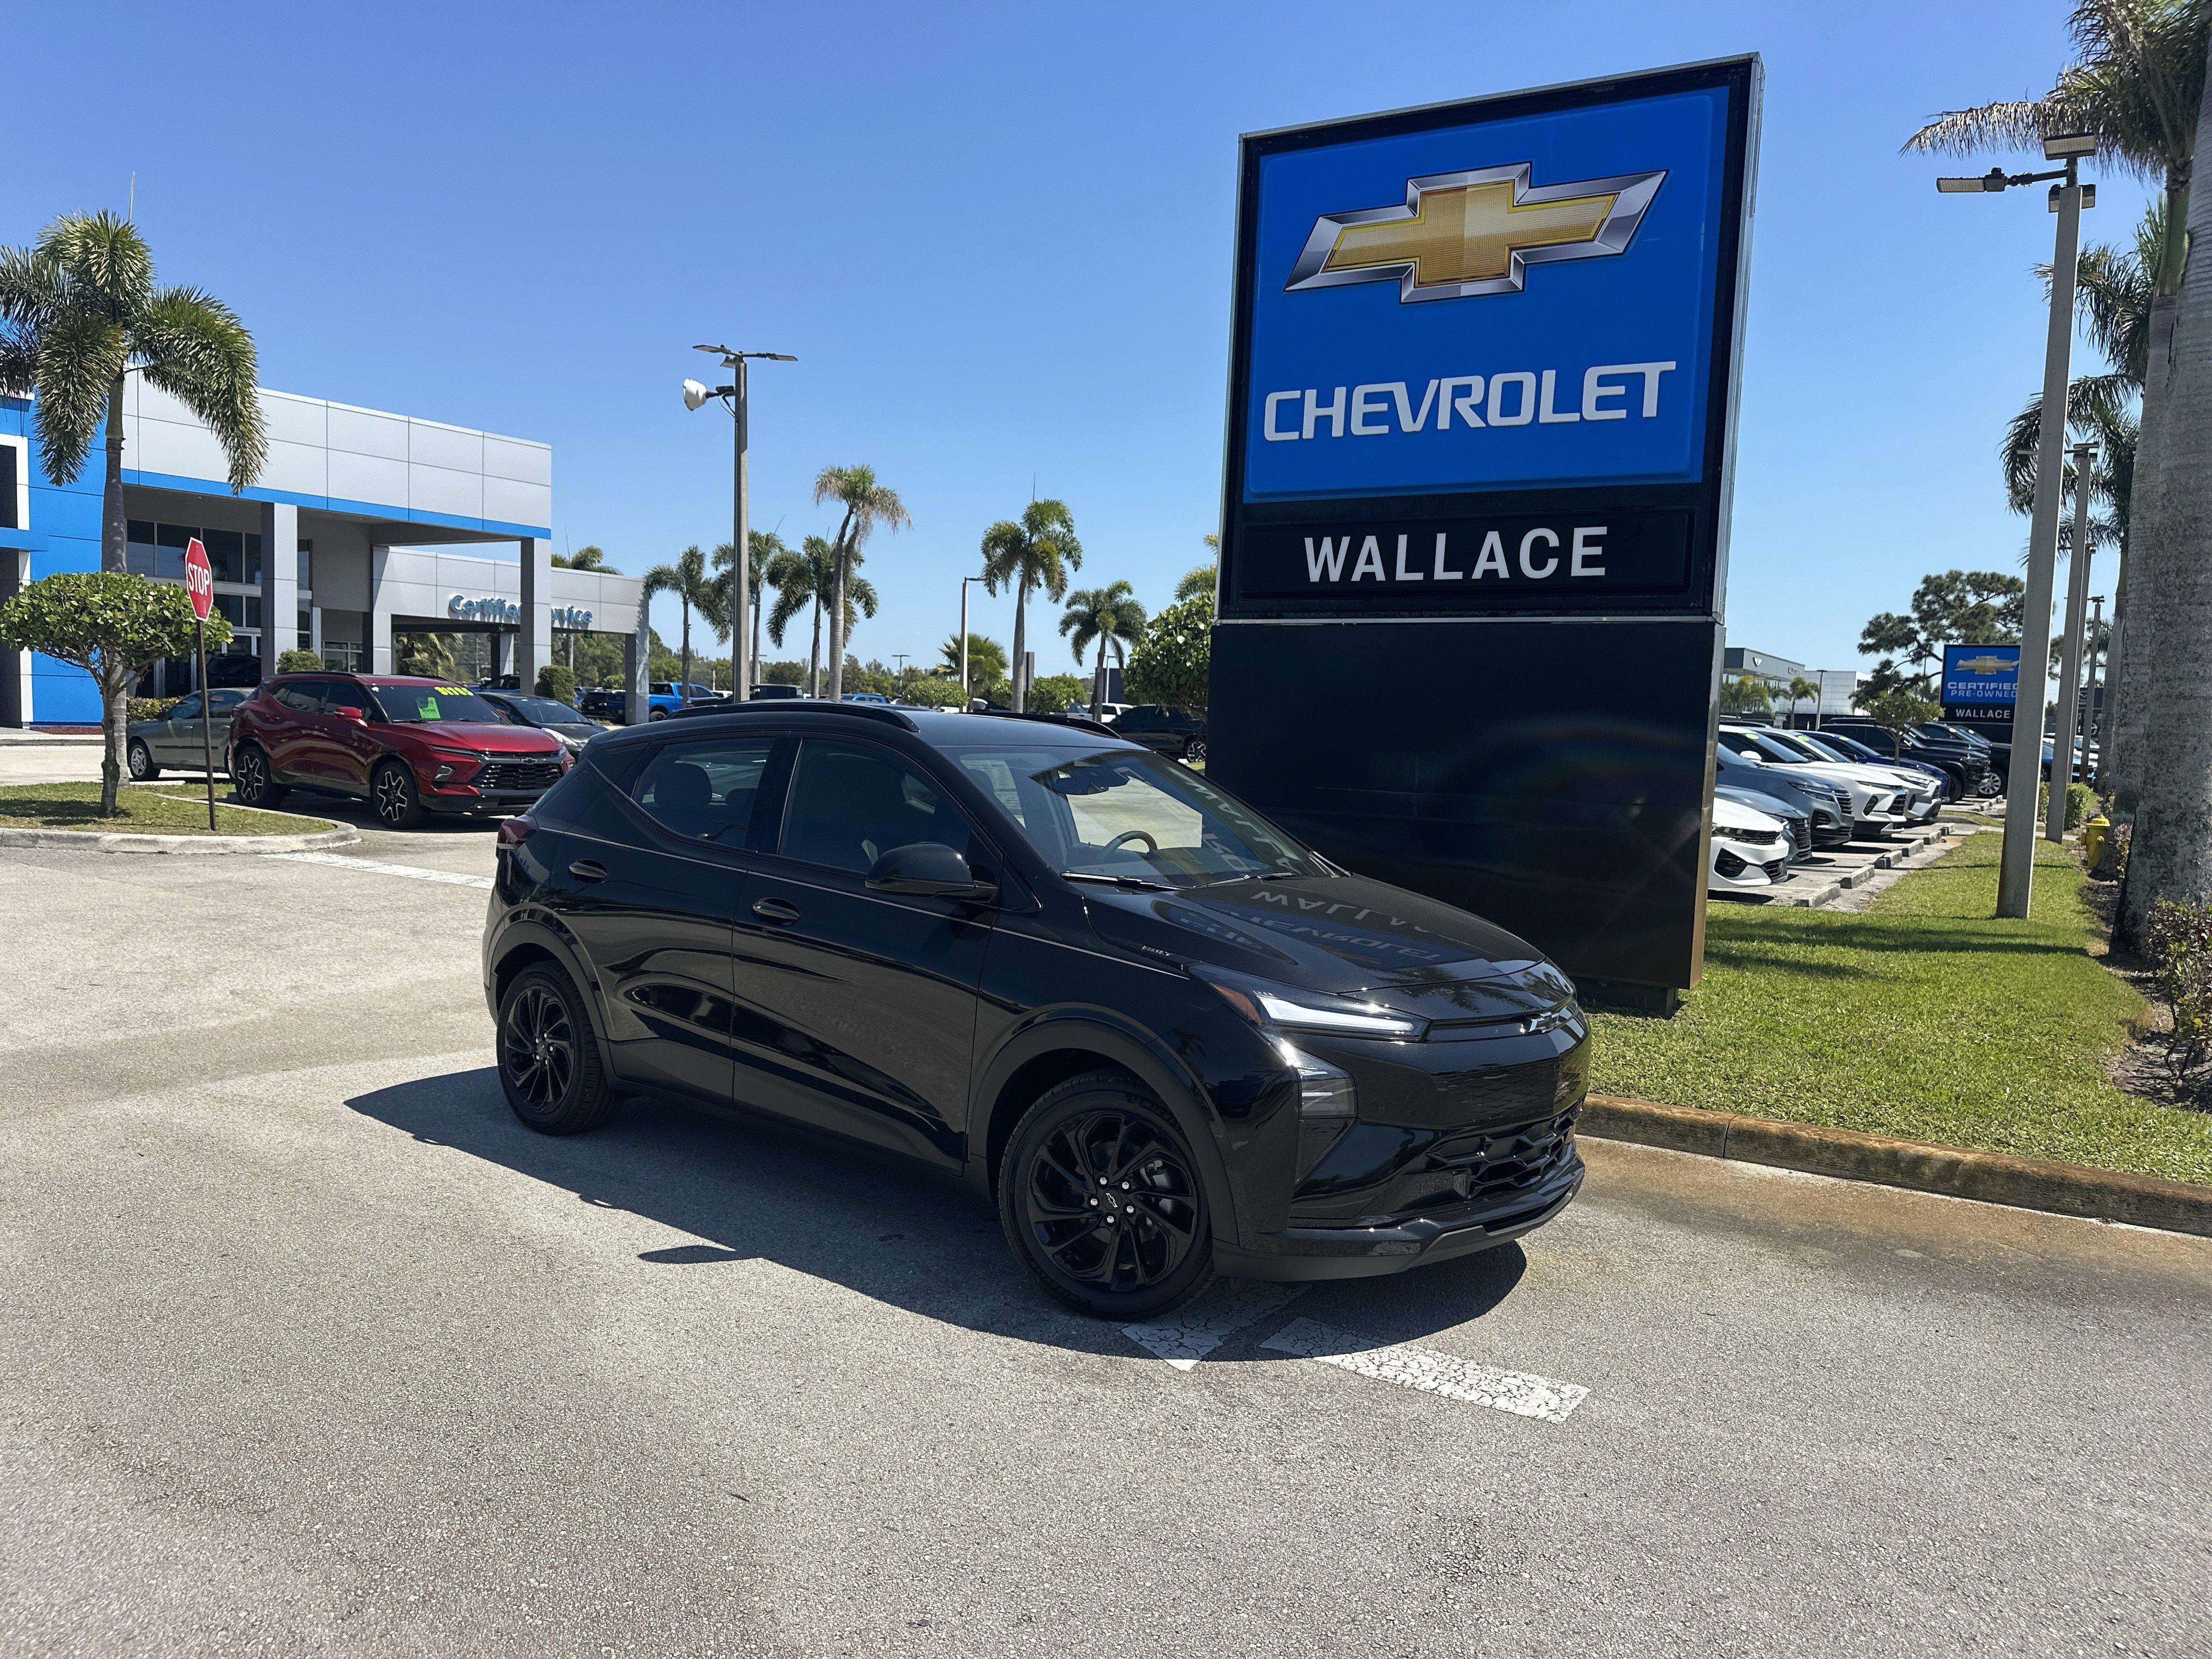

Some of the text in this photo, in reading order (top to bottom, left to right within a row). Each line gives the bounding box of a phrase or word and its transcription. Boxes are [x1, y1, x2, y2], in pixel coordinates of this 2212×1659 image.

[1264, 360, 1676, 442] CHEVROLET
[1305, 527, 1608, 583] WALLACE
[188, 562, 210, 596] STOP
[450, 595, 592, 624] Certifie rvice
[1955, 709, 2011, 719] WALLACE
